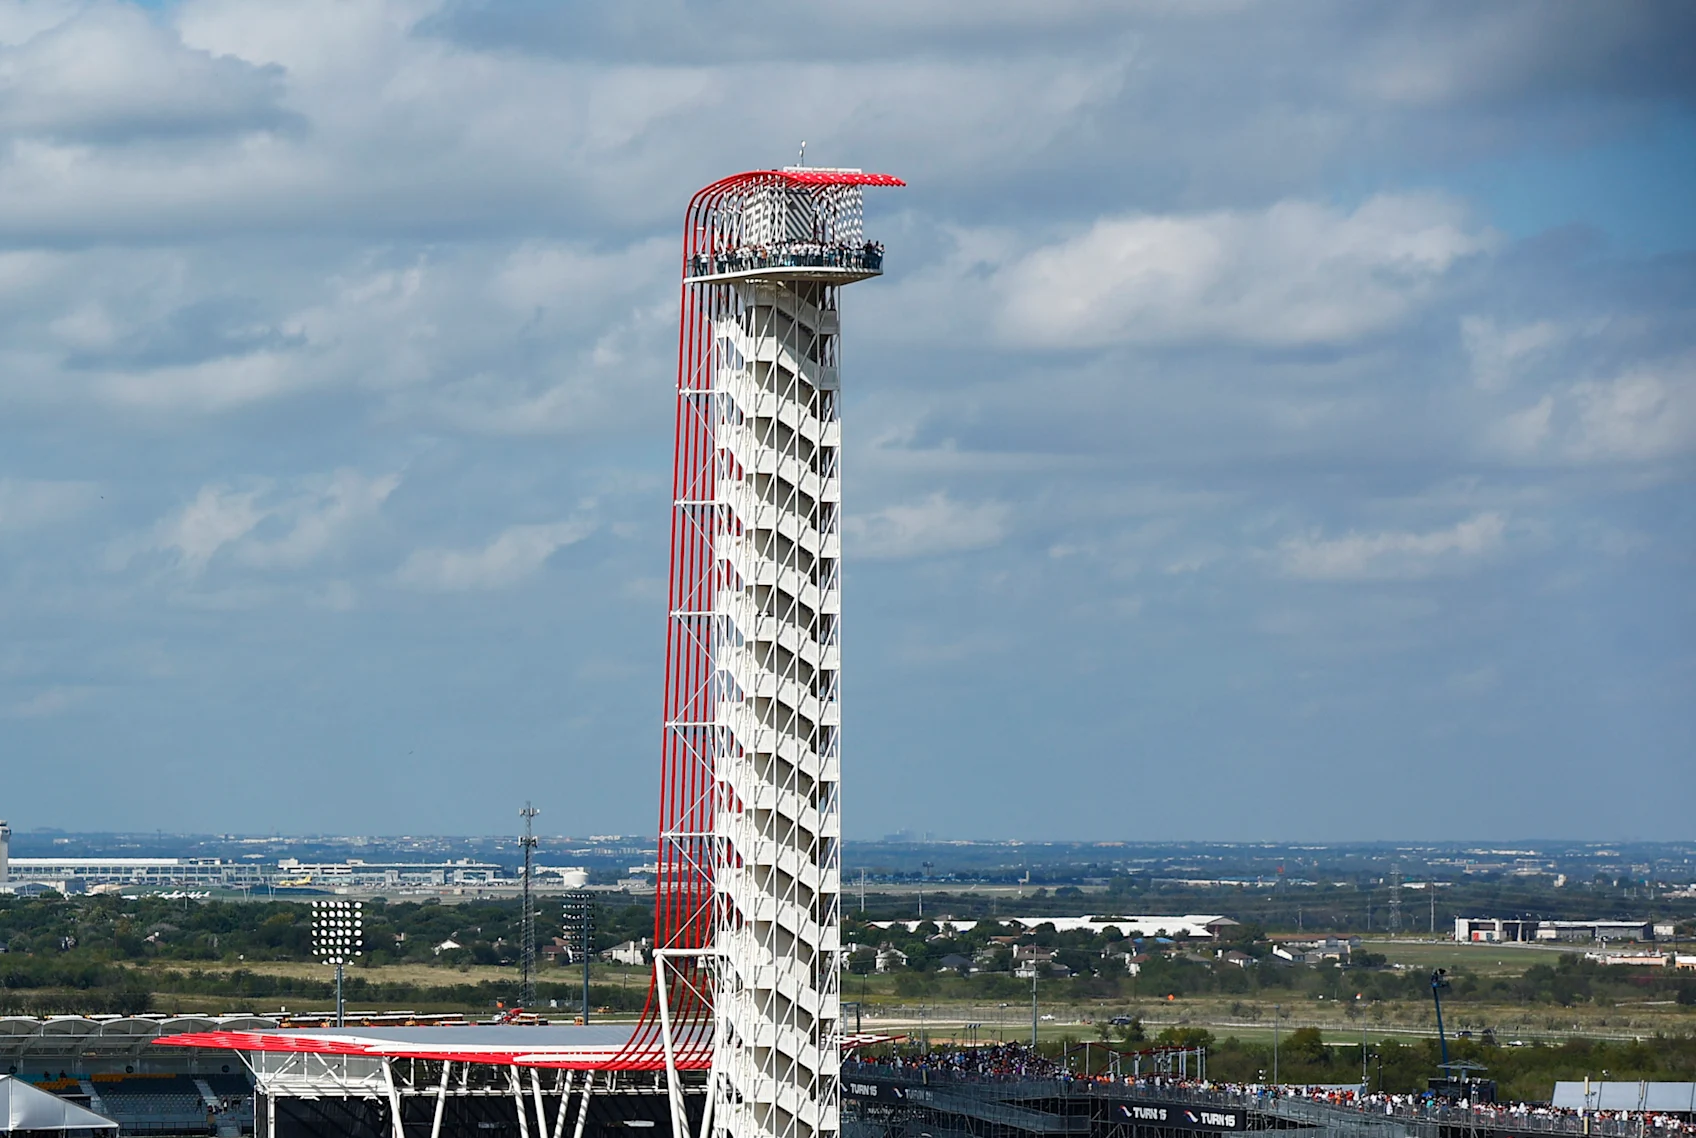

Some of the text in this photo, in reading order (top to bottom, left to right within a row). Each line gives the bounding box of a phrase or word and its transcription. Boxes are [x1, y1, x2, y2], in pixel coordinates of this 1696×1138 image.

[850, 1083, 870, 1095] TURN
[1133, 1106, 1158, 1120] TURN
[1201, 1112, 1236, 1128] TURN 15
